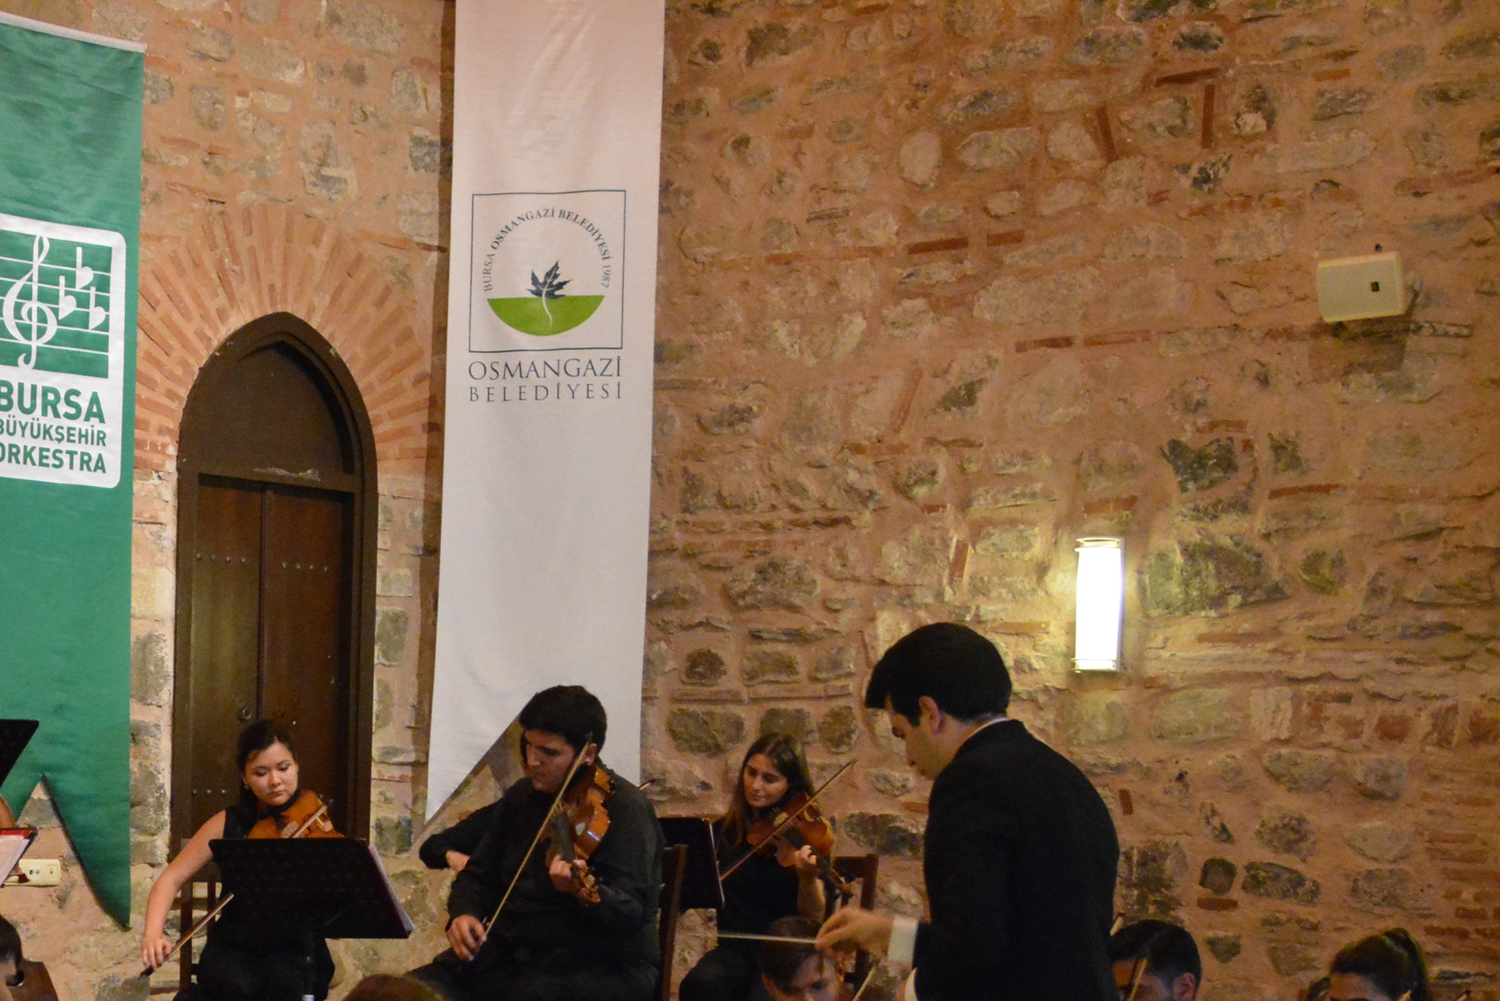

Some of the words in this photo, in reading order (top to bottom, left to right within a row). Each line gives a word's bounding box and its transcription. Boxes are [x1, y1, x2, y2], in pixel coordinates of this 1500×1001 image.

[482, 253, 496, 292] BURSA
[490, 208, 556, 250] OSMANGAZİ
[557, 209, 613, 261] BELEDİYESİ
[601, 264, 612, 289] 1987
[468, 355, 622, 381] OSMANGAZİ
[469, 381, 622, 403] BELEDİYESİ
